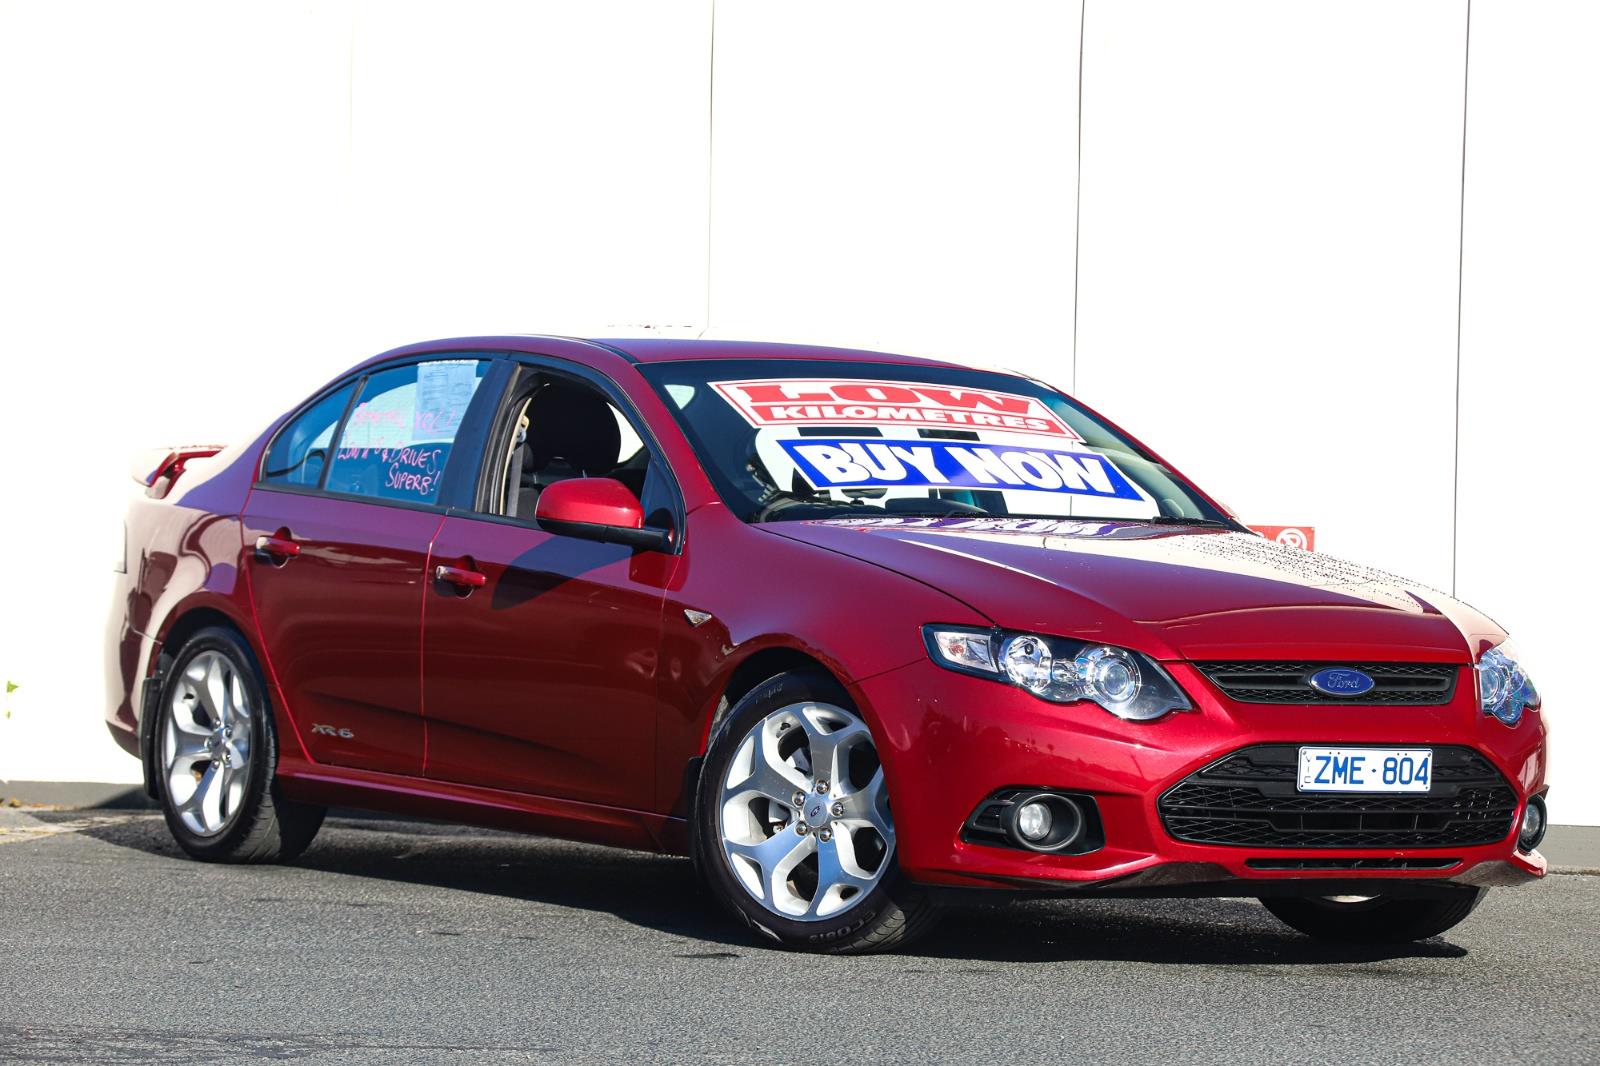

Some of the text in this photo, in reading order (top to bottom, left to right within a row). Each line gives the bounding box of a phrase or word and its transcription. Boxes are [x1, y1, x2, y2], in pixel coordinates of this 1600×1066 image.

[737, 384, 1030, 414] LOW
[769, 405, 1050, 431] KILOMETRES
[793, 442, 1116, 494] BUY NOW
[1327, 672, 1362, 689] Ford
